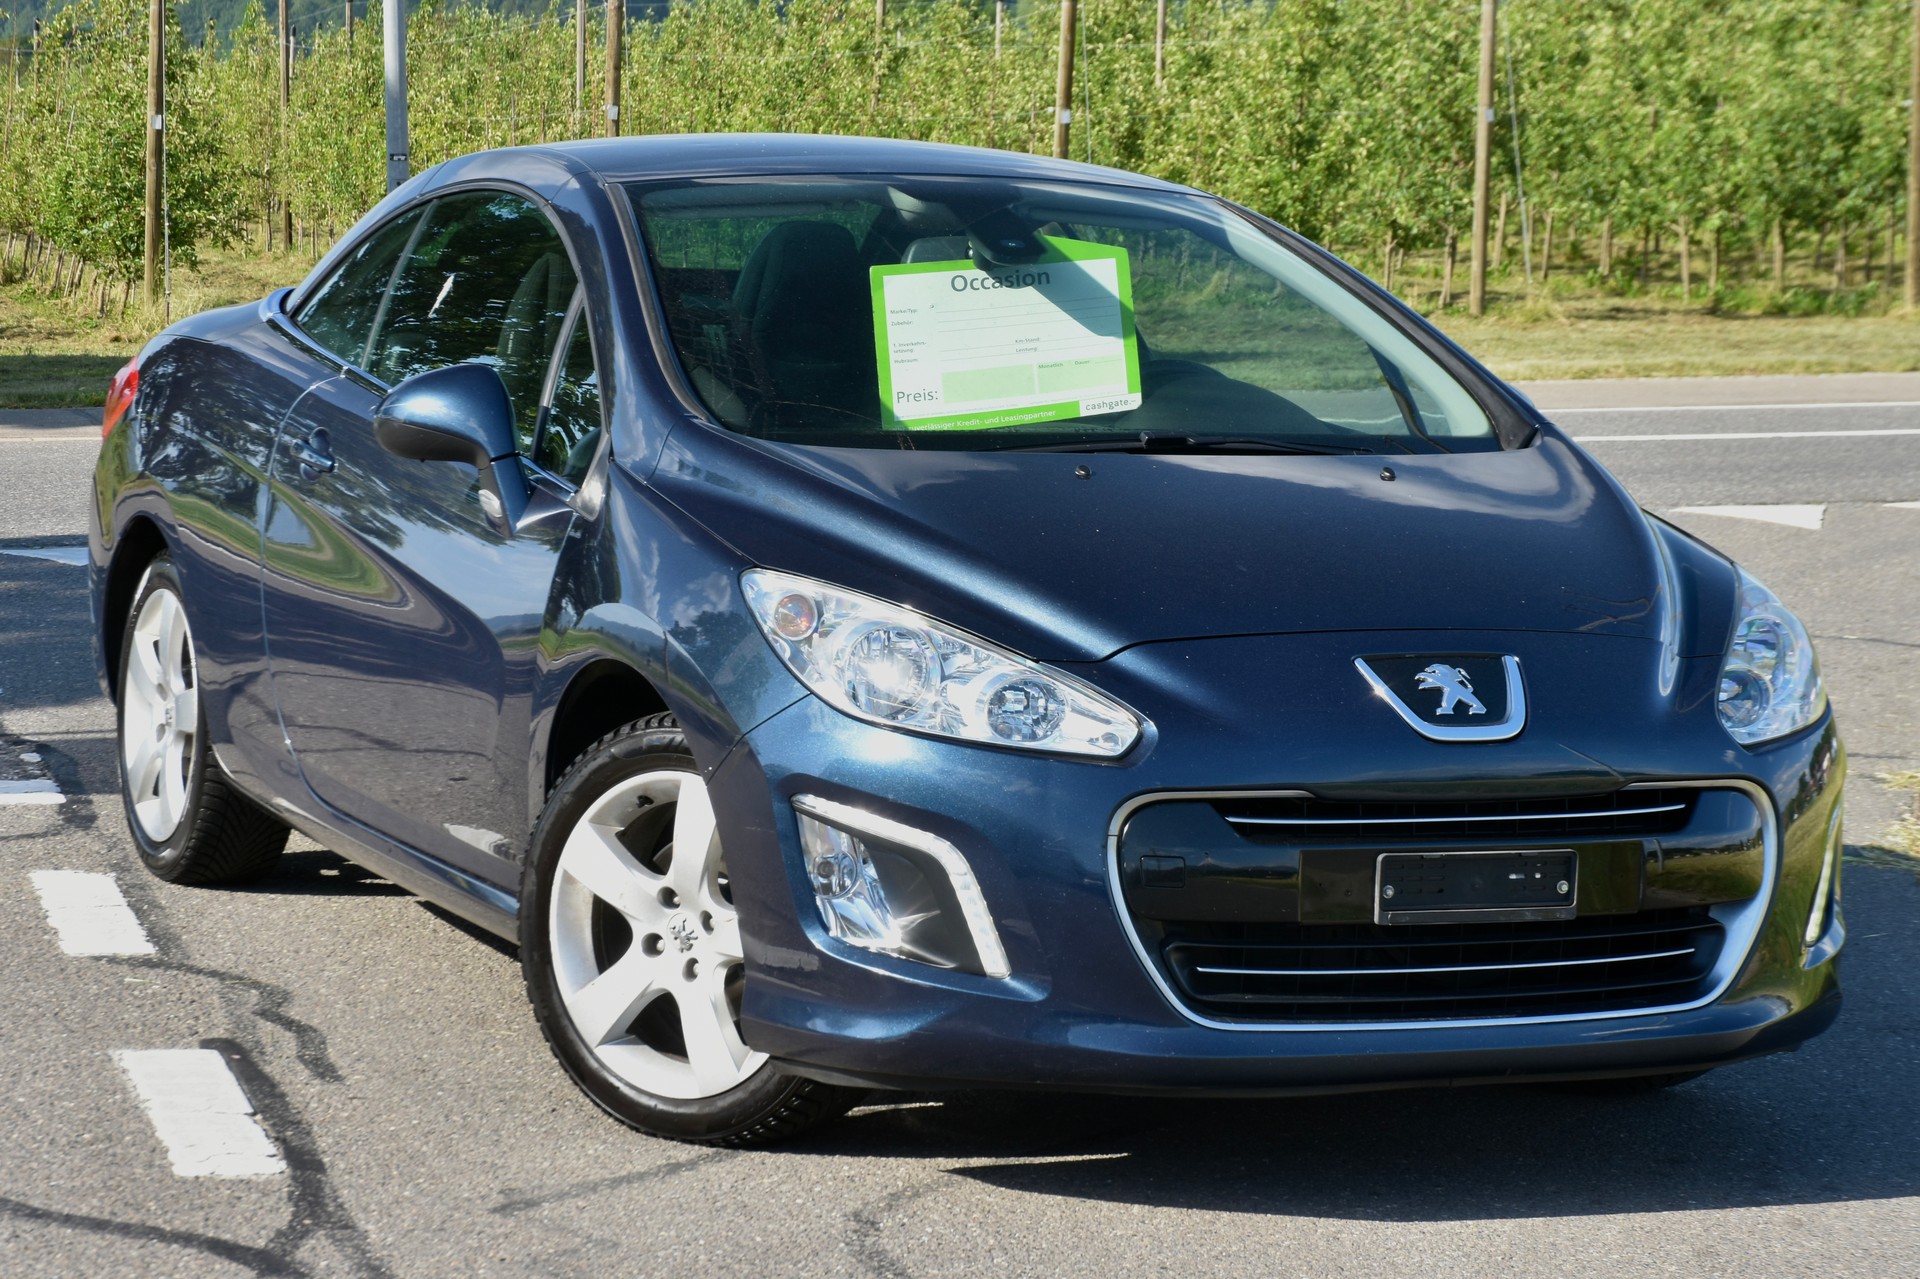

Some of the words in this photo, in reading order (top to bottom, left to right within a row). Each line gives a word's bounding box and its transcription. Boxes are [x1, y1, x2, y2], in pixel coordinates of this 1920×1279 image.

[951, 269, 1051, 292] Occasion
[896, 388, 939, 405] Preis:
[957, 419, 982, 427] Kredit-
[984, 417, 1000, 425] und
[1001, 411, 1056, 422] Leasingpartner
